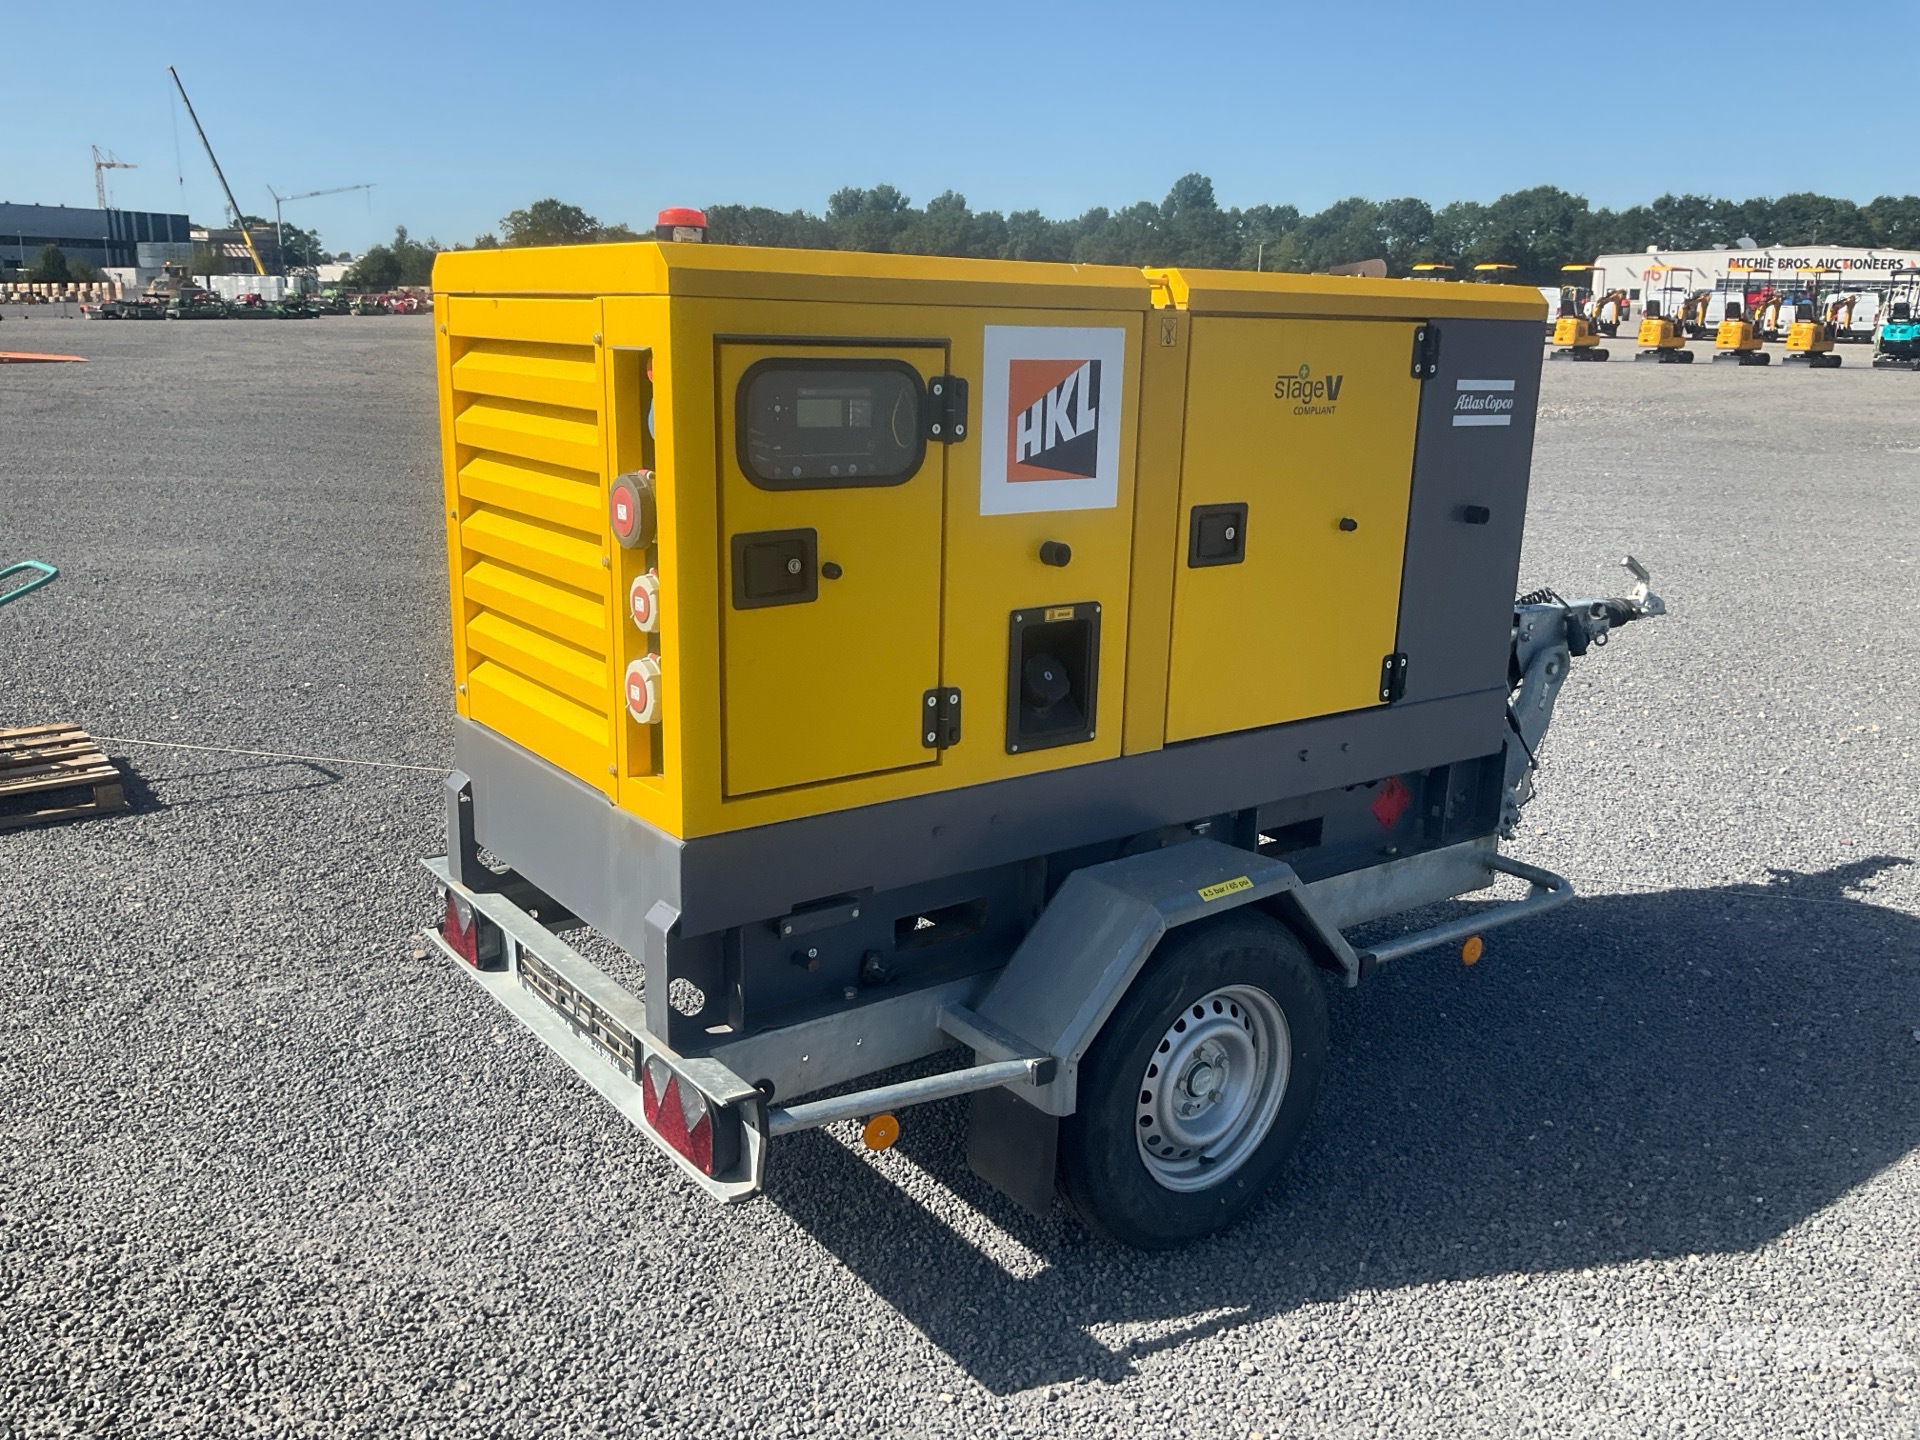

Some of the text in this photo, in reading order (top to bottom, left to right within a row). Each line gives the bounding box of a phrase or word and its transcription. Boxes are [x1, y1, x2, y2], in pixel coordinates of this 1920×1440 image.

[1728, 257, 1774, 269] RITCHIE
[1777, 258, 1812, 269] BROS.
[1454, 393, 1514, 413] Atlas Copco
[1015, 360, 1096, 463] HKL
[1293, 405, 1337, 416] COMPLIANT
[1213, 887, 1225, 895] bar
